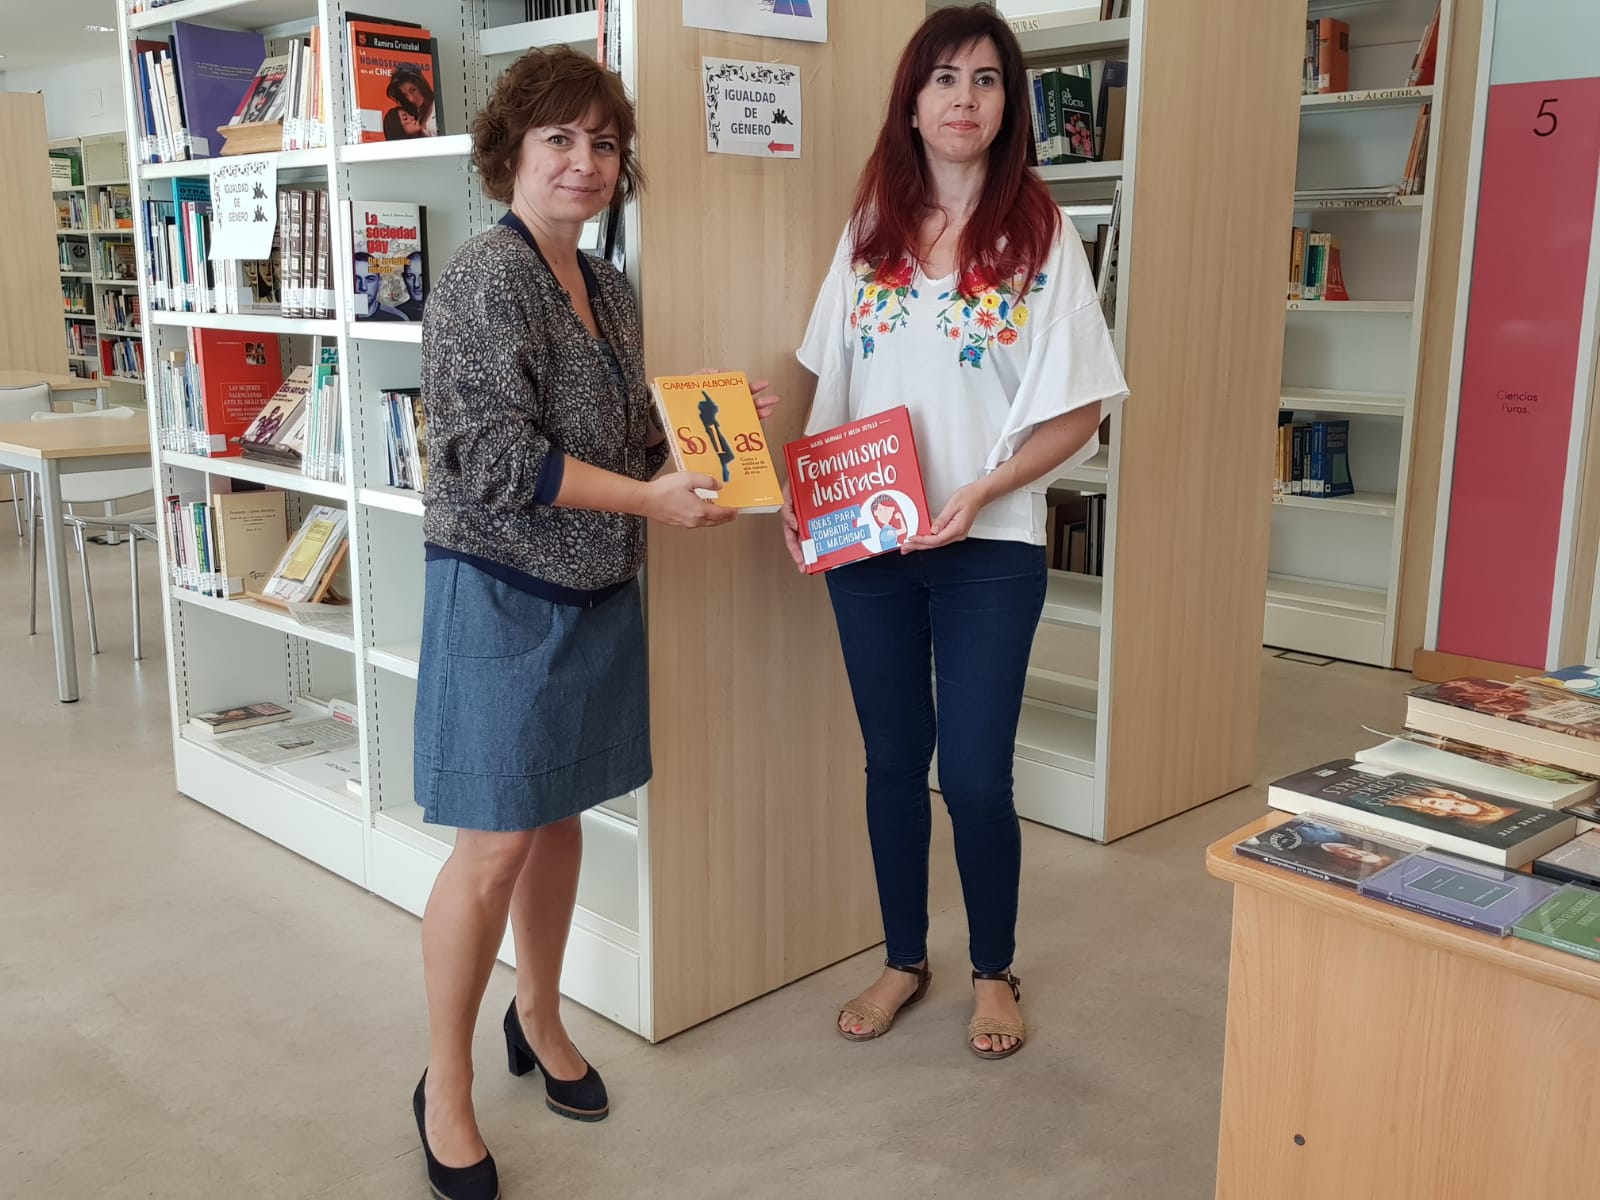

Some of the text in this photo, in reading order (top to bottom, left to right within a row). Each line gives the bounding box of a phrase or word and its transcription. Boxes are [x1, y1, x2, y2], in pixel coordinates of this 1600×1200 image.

[1012, 19, 1039, 32] PURAS
[374, 38, 394, 48] Ramiro
[375, 67, 392, 77] CINE
[724, 88, 776, 104] IGUALDAD
[1336, 94, 1354, 102] 513
[1364, 89, 1421, 100] ÁLGEBRA
[744, 107, 758, 119] DE
[1532, 98, 1558, 137] 5
[730, 120, 772, 136] GÉNERO
[224, 183, 249, 194] IGUALDAD
[234, 198, 240, 208] DE
[1343, 198, 1402, 208] TOPOLOGÍA
[228, 210, 248, 222] GÉNERO
[365, 212, 378, 226] La
[366, 226, 416, 240] sociedad
[367, 240, 388, 254] gay
[662, 378, 744, 390] CARMEN ALBORCH
[1496, 390, 1538, 402] Ciencias
[1502, 403, 1528, 414] Puras
[797, 434, 900, 483] Feminismo
[812, 460, 897, 508] ilustrado
[811, 509, 856, 530] IDEAS PARA
[814, 522, 850, 541] COMBATIR
[816, 528, 866, 552] EL MACHISMO
